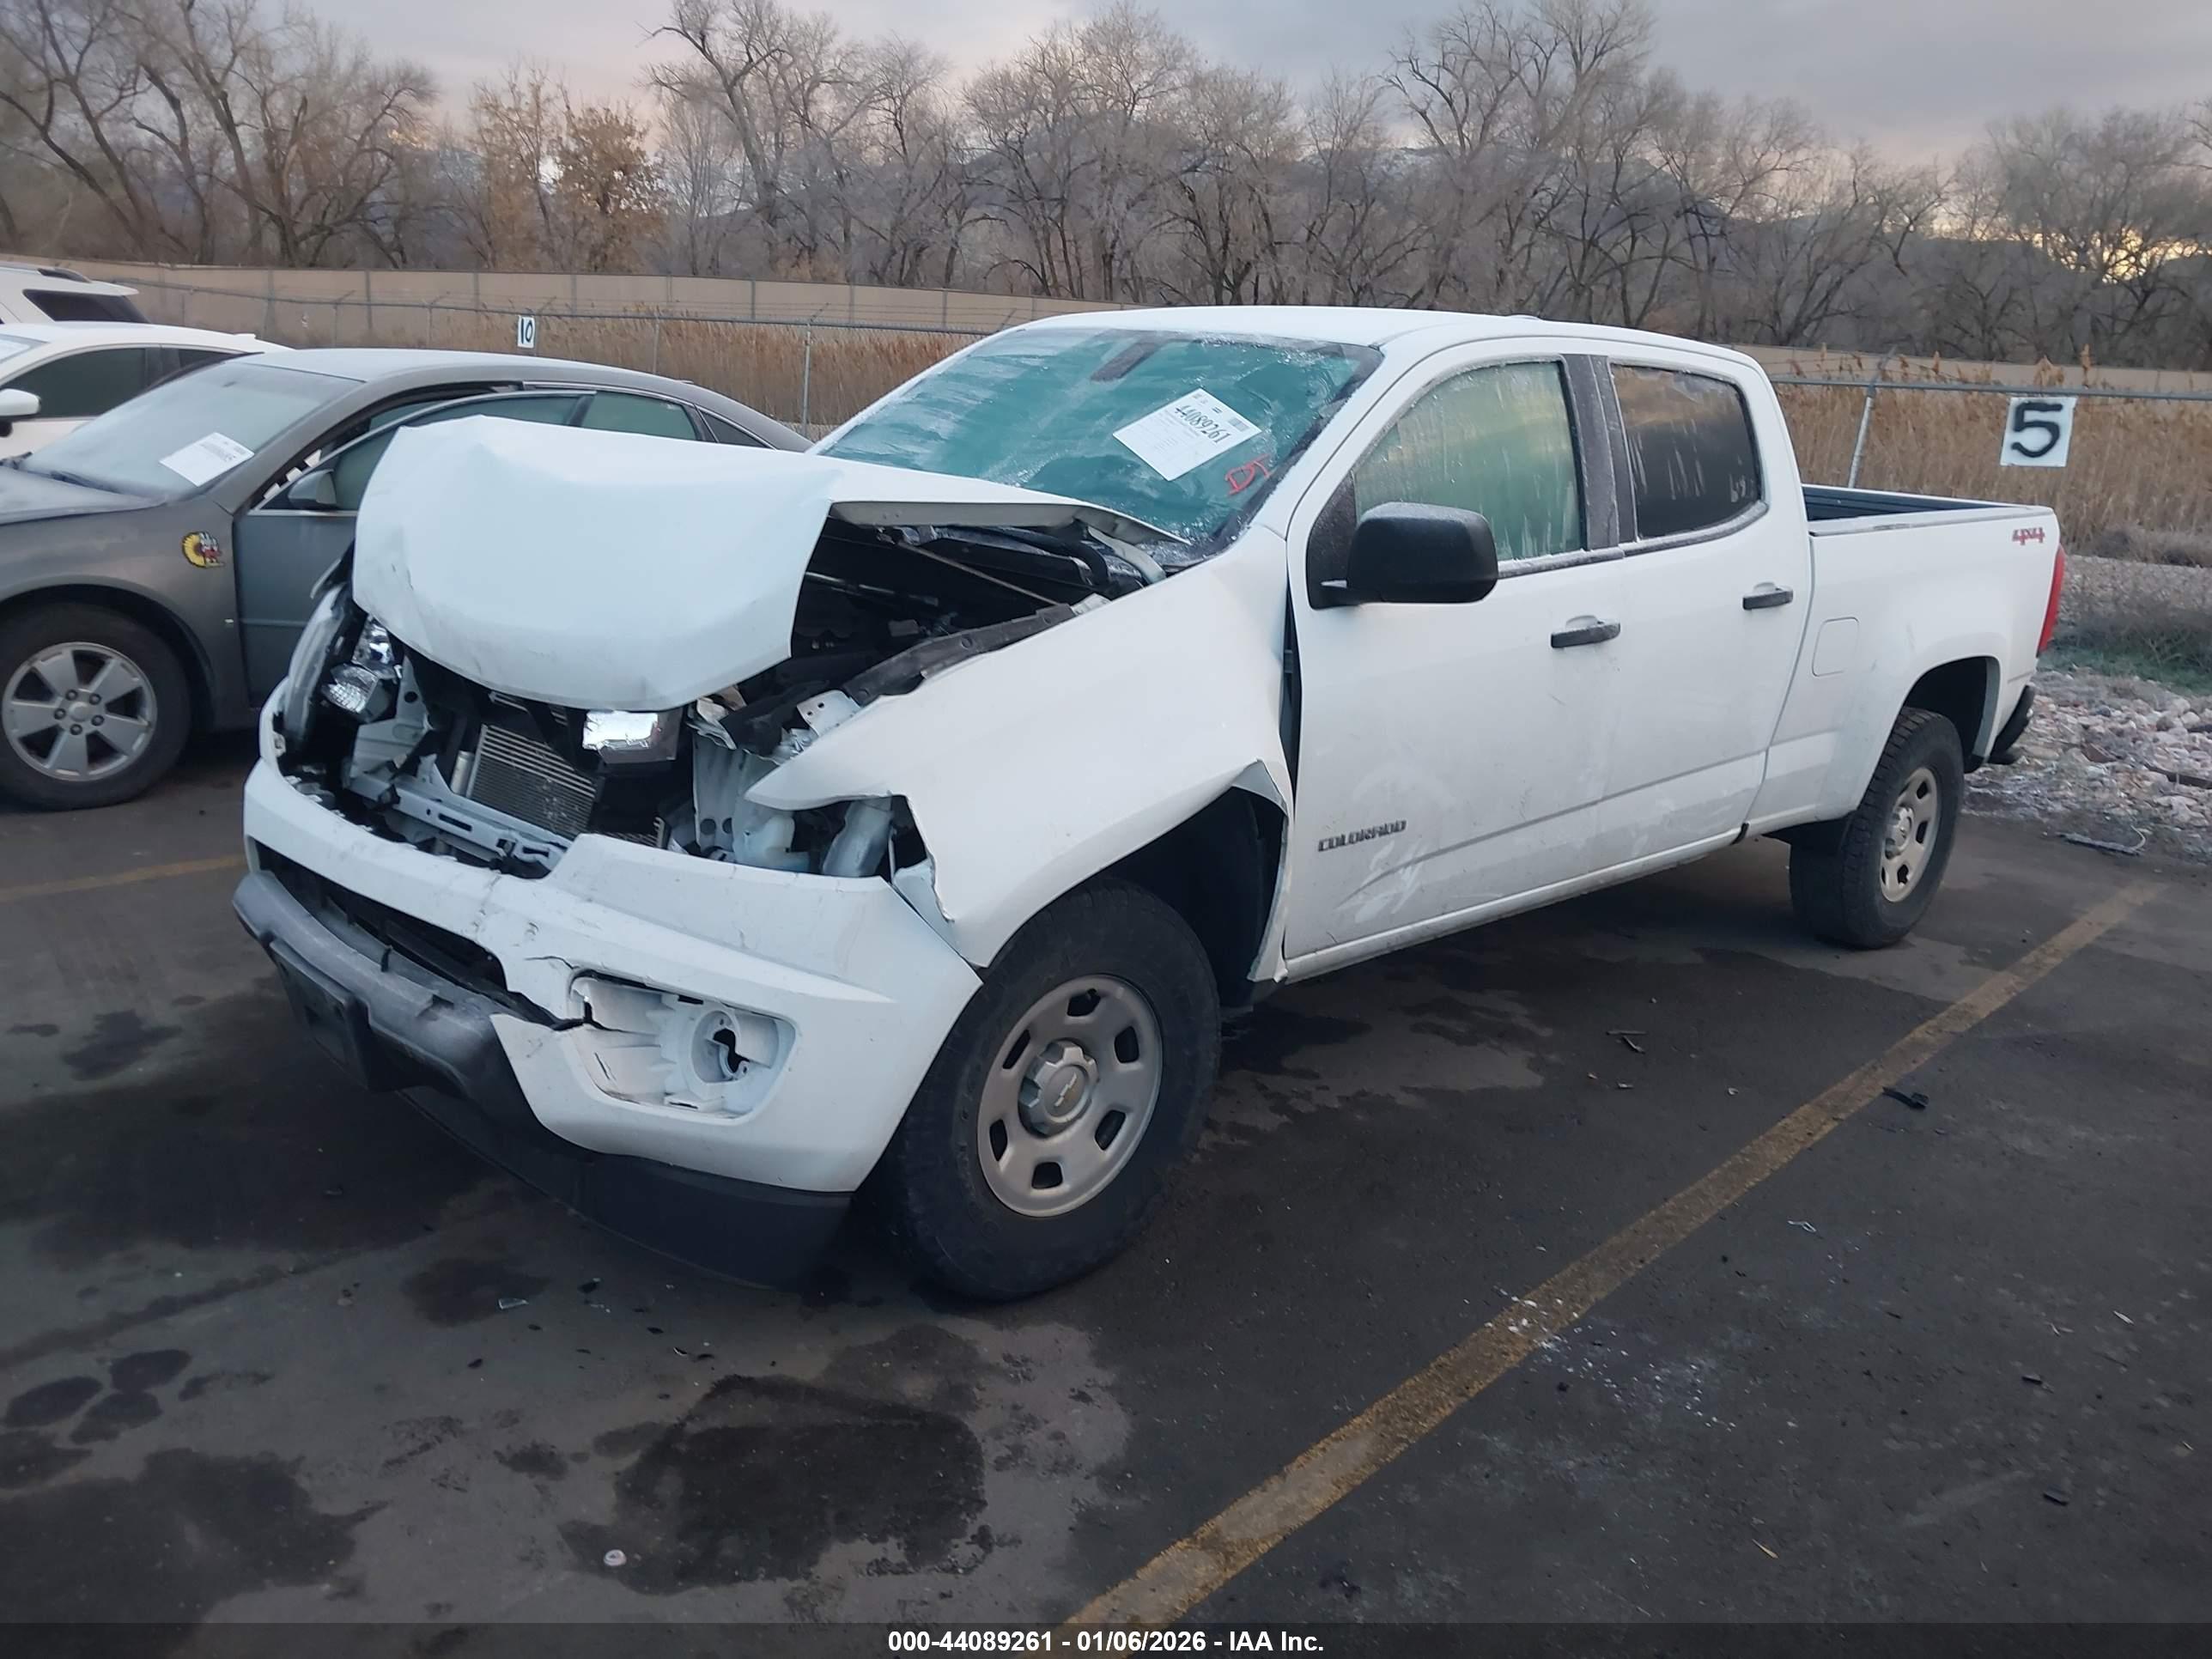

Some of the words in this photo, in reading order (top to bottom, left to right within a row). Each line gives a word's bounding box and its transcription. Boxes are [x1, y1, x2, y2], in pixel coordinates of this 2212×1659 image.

[520, 318, 533, 344] 10
[1174, 404, 1231, 444] 44089261
[2010, 401, 2063, 459] 5
[1317, 819, 1407, 853] COLORADO
